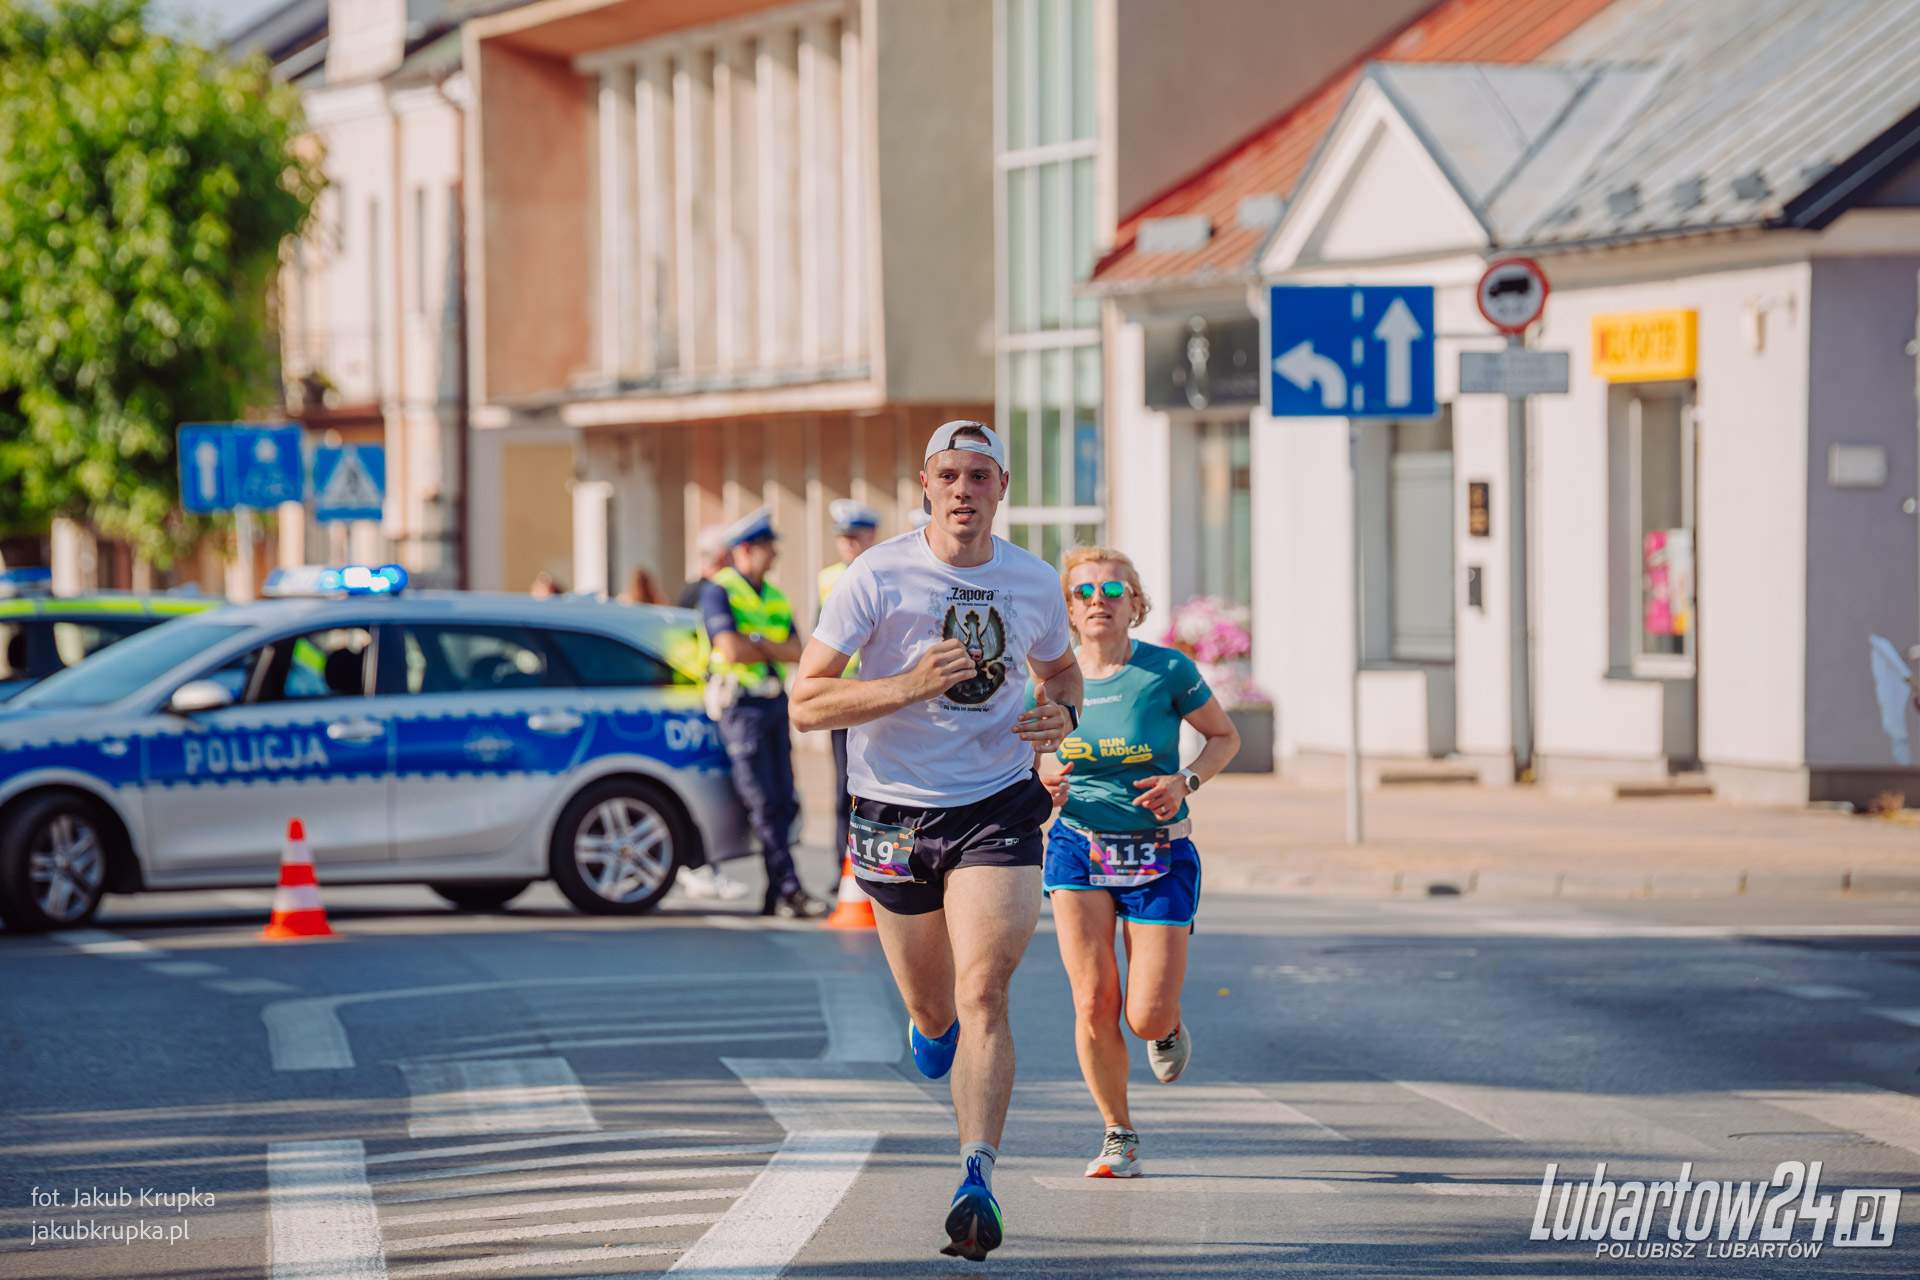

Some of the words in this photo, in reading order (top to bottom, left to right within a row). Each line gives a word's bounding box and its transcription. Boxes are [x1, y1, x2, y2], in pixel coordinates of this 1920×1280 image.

[1099, 737, 1126, 747] RUN
[1101, 743, 1153, 758] RADICAL
[184, 734, 329, 776] POLICJA
[849, 833, 894, 864] 119
[1105, 842, 1157, 866] 113
